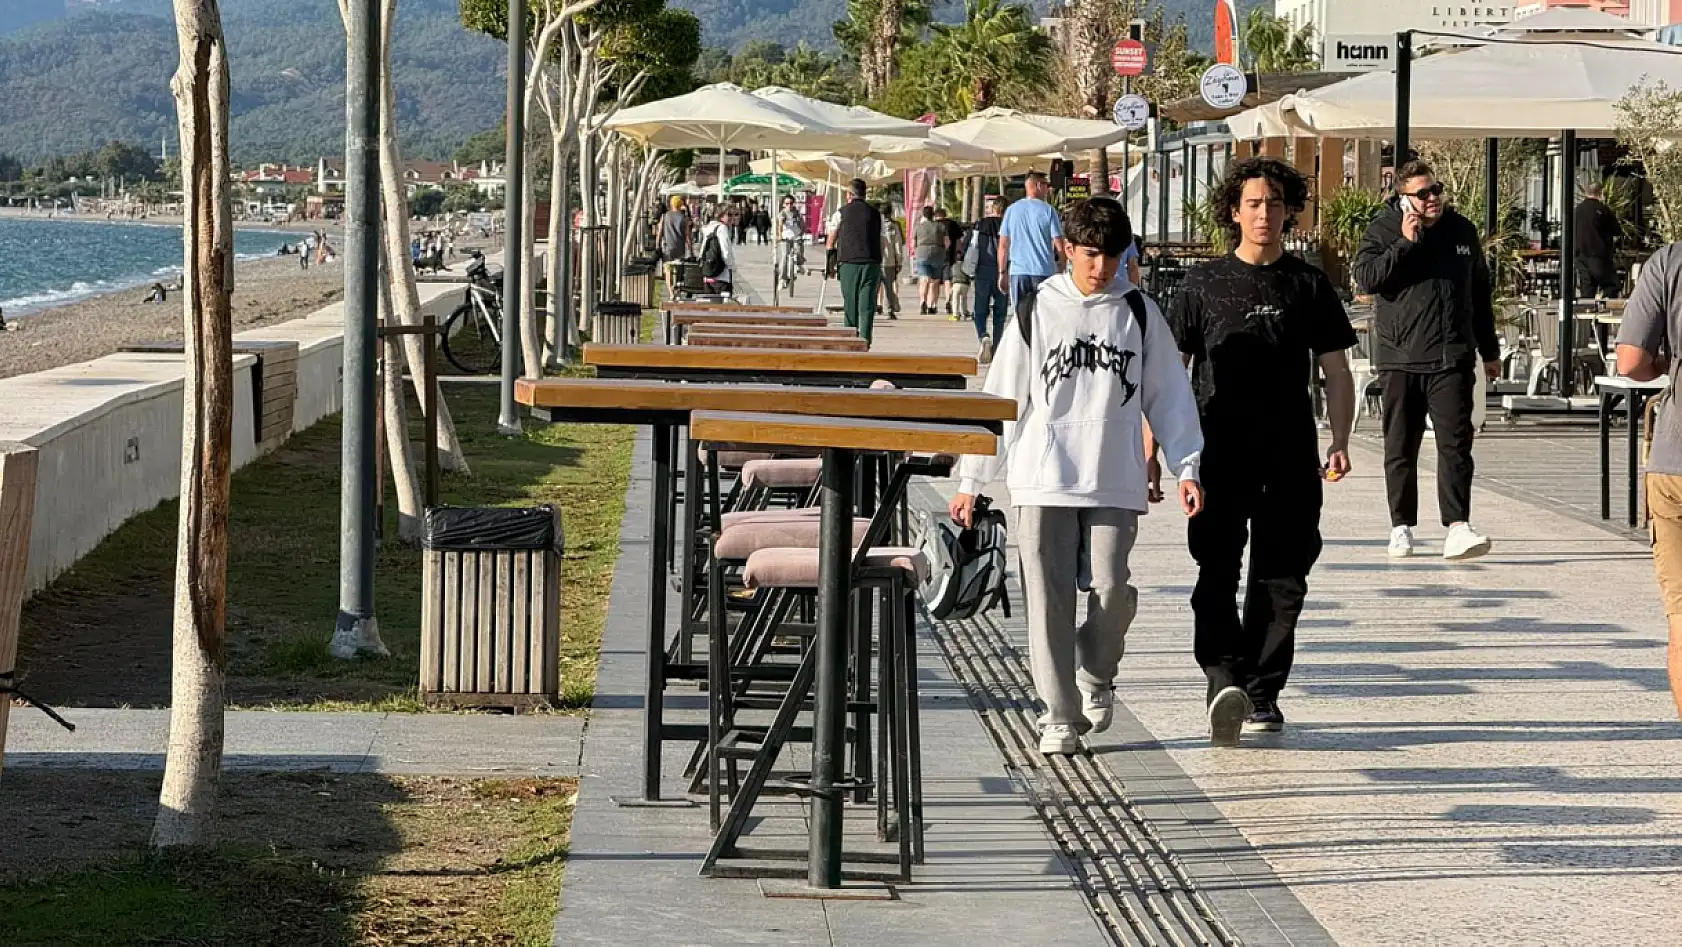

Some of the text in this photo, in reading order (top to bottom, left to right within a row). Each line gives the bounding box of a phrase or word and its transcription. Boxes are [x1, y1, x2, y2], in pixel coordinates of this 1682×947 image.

[1432, 7, 1516, 16] LIBERT
[1115, 47, 1142, 55] SUNSET
[1337, 41, 1388, 59] hann
[1456, 245, 1471, 255] HH
